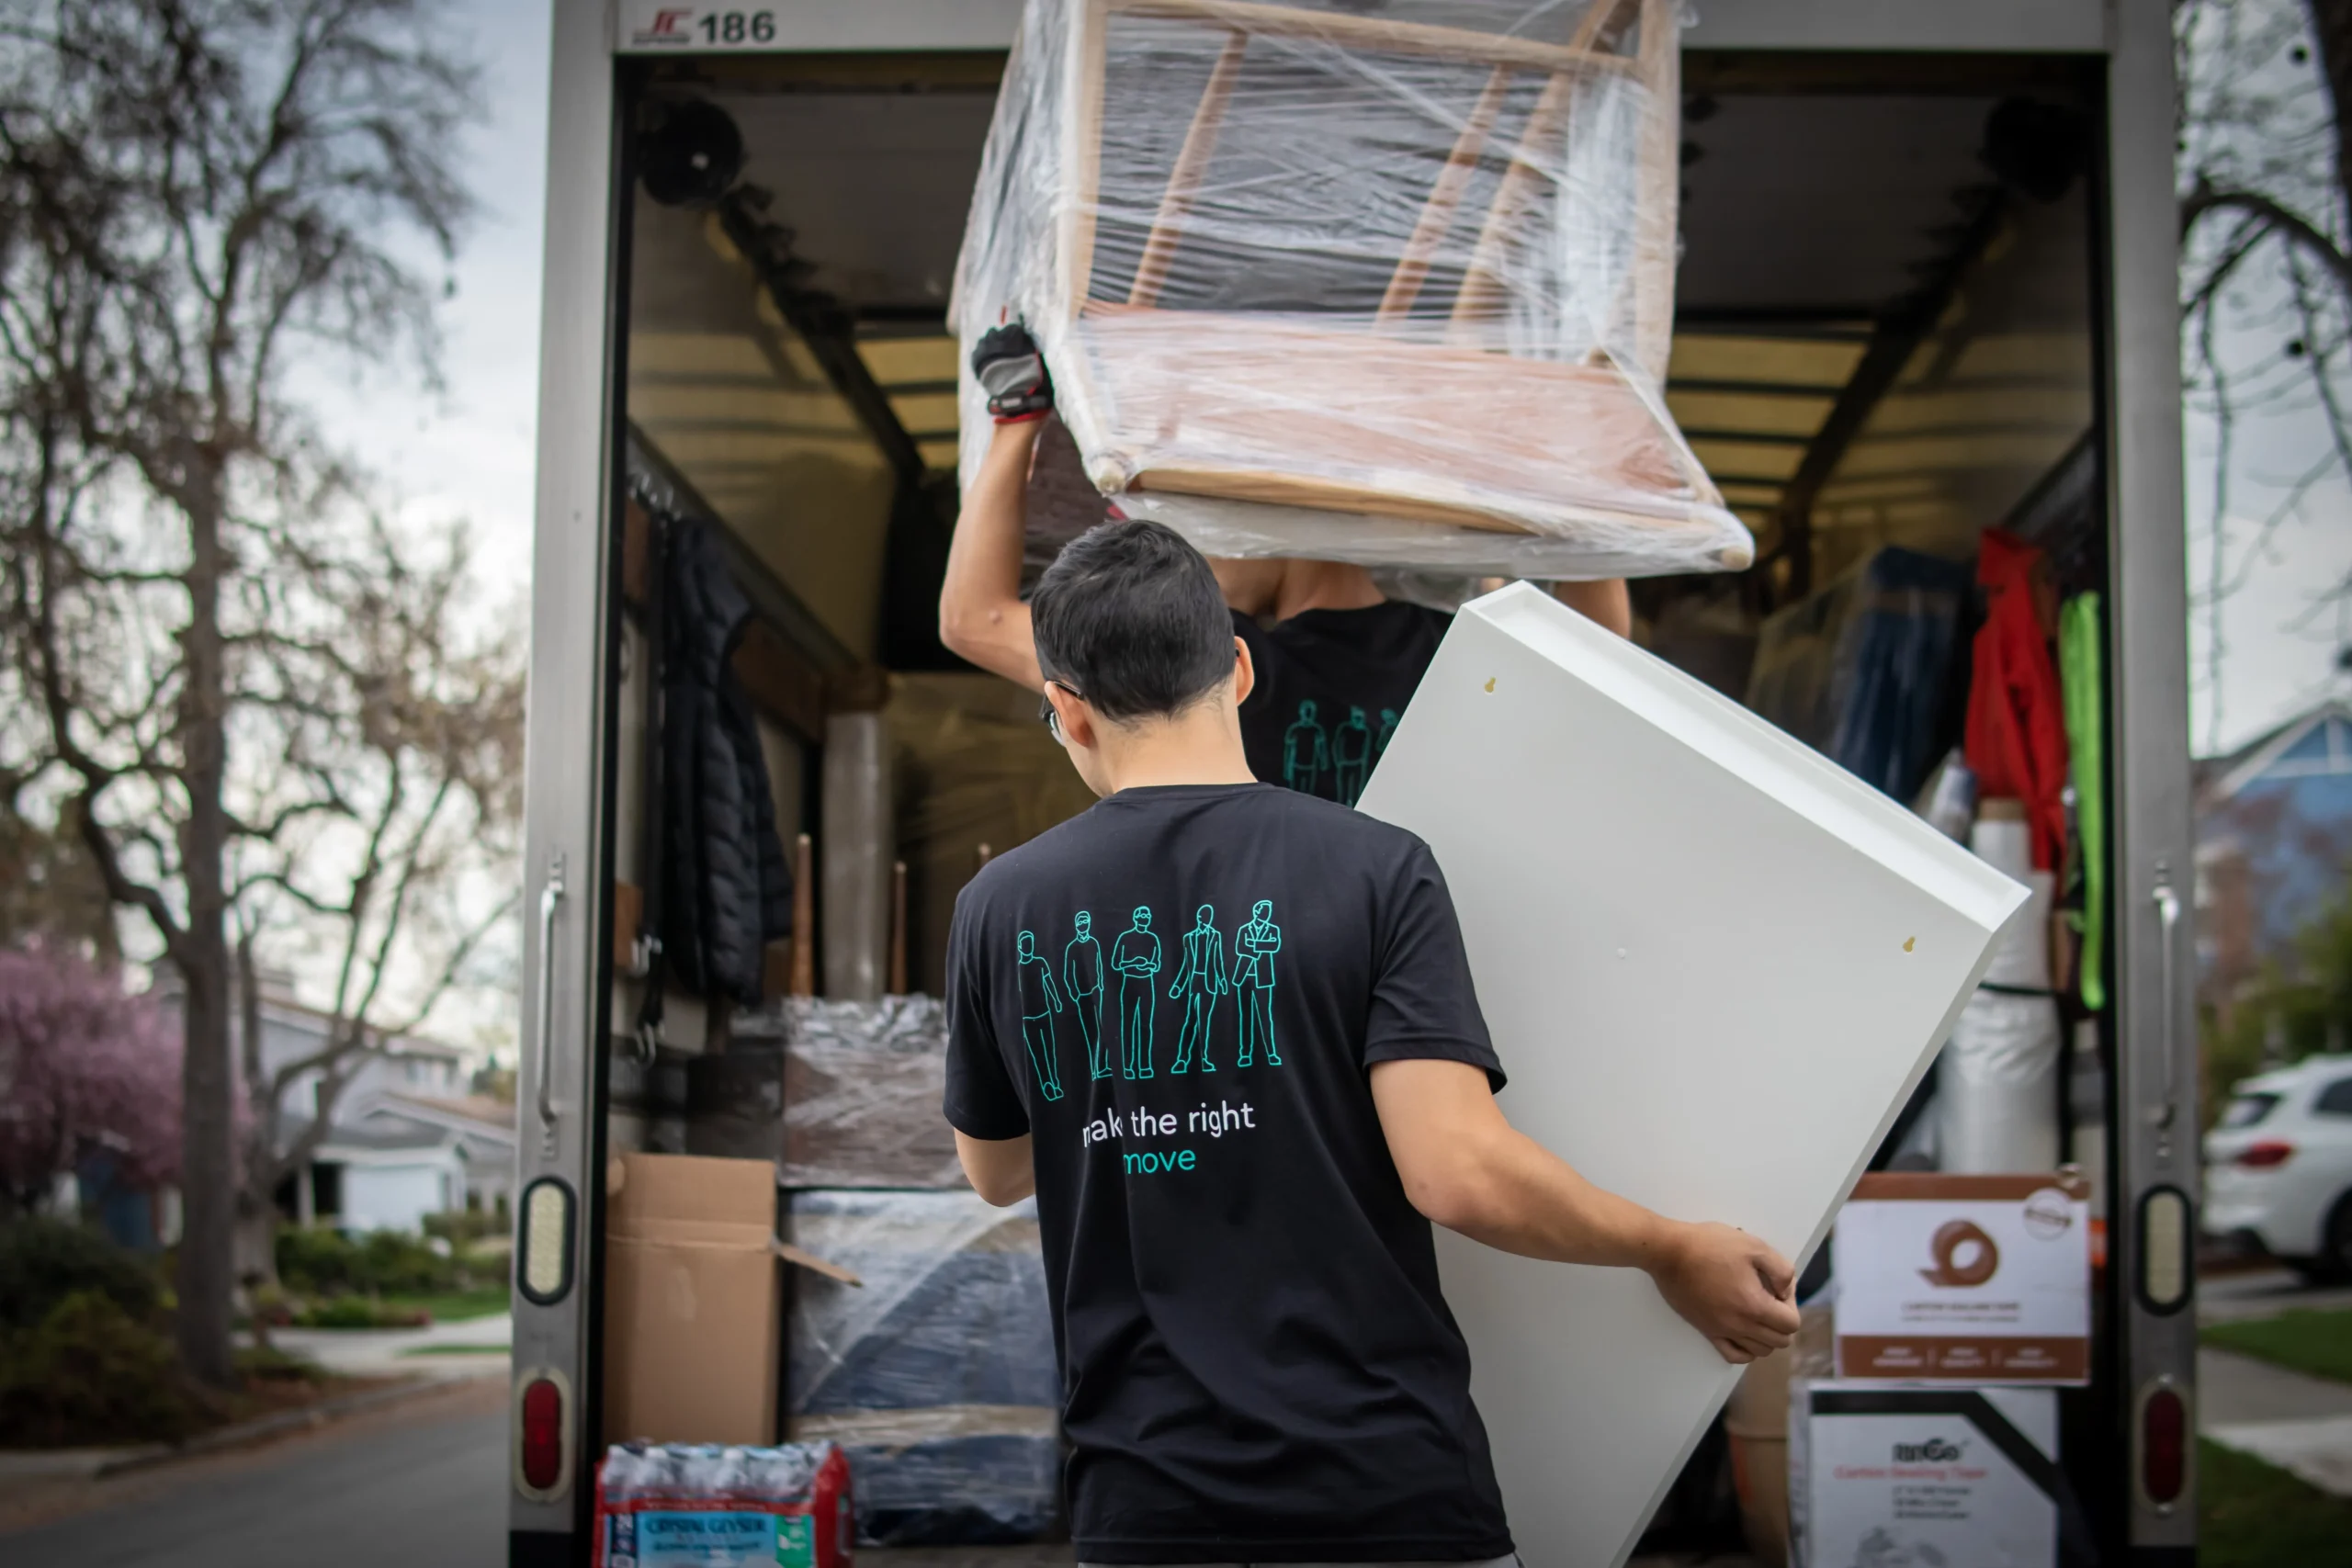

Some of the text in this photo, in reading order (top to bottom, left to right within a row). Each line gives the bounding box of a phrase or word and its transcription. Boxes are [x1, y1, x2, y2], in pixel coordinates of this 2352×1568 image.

[698, 11, 775, 43] 186
[1131, 1106, 1178, 1137] the
[1189, 1100, 1257, 1138] right
